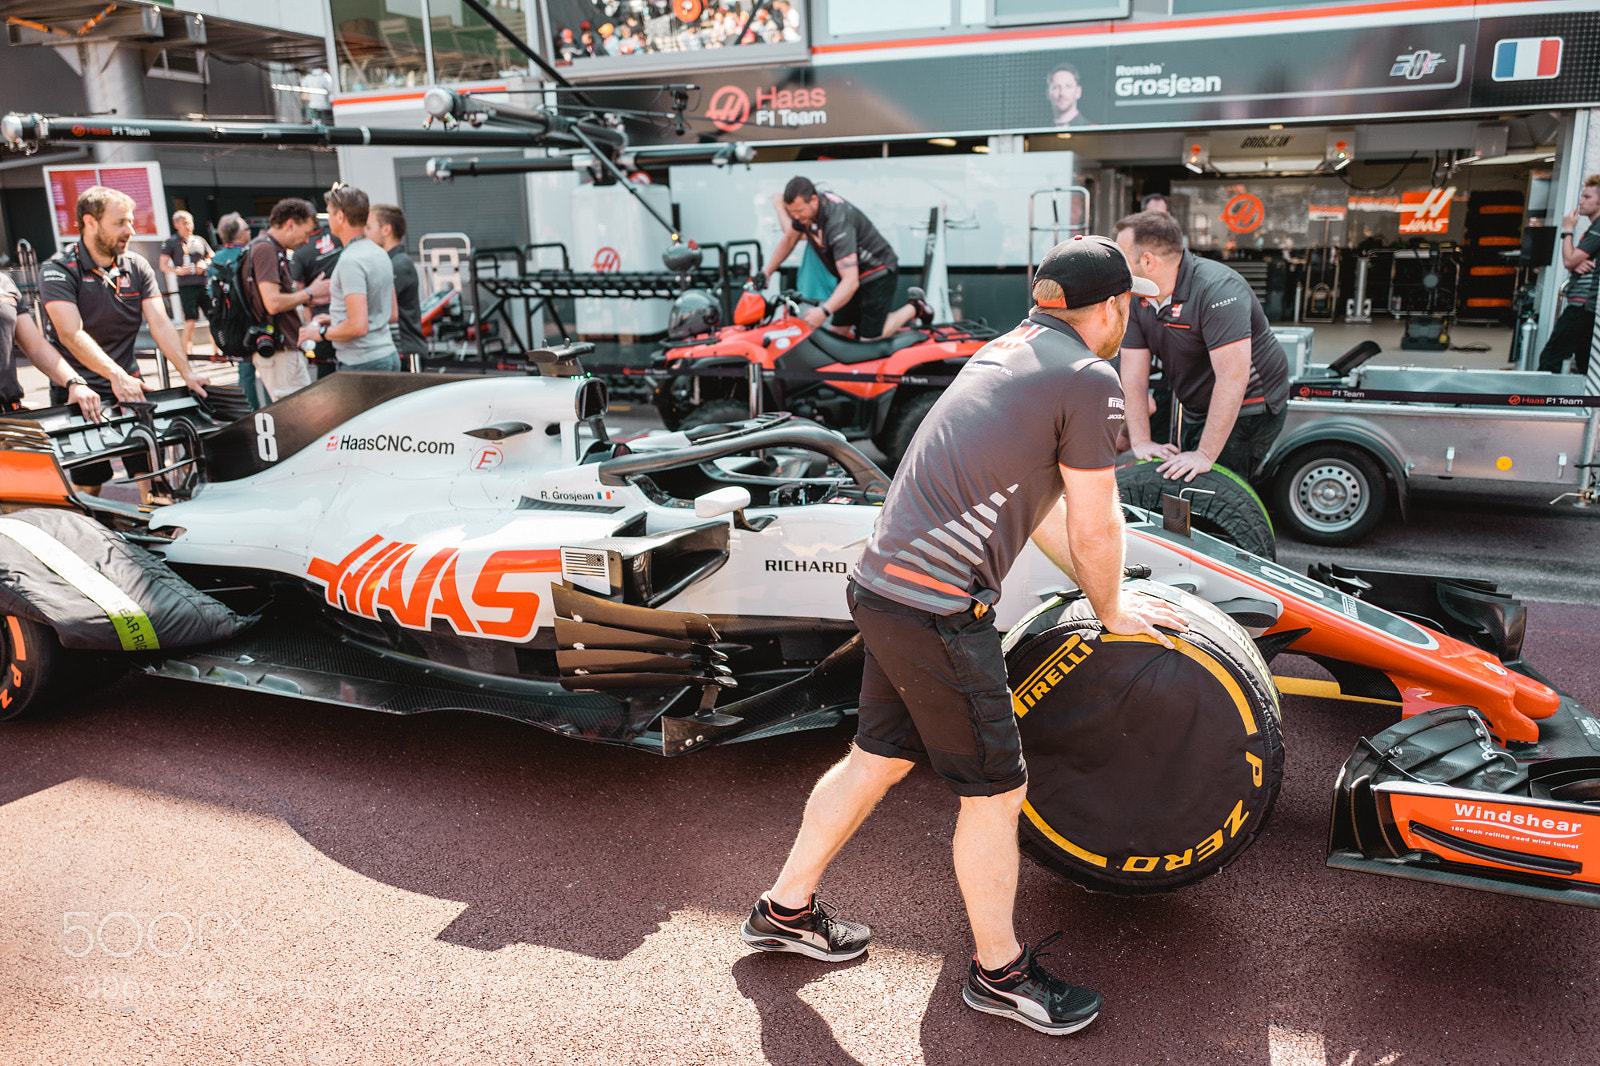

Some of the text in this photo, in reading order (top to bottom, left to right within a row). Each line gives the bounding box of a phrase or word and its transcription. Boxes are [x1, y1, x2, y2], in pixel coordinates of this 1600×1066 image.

[1115, 62, 1162, 77] Romain
[1115, 73, 1222, 97] Grosjean
[756, 86, 827, 109] Haas
[756, 109, 827, 126] F1 Team
[124, 126, 151, 136] Team
[1311, 388, 1332, 396] Haas
[1521, 396, 1545, 404] Haas
[1558, 397, 1583, 405] Team
[254, 412, 279, 462] 8
[340, 434, 455, 455] HaasCNC.com
[541, 490, 595, 502] R. Grosjean
[765, 559, 847, 574] RICHARD
[307, 533, 562, 639] HAAS
[1011, 634, 1094, 719] PIRELLI
[1121, 751, 1263, 873] P ZERO
[1454, 802, 1582, 833] Windshear
[1466, 828, 1483, 836] mph
[1512, 835, 1530, 843] road
[1532, 838, 1551, 846] wind
[1553, 841, 1580, 850] tunnel
